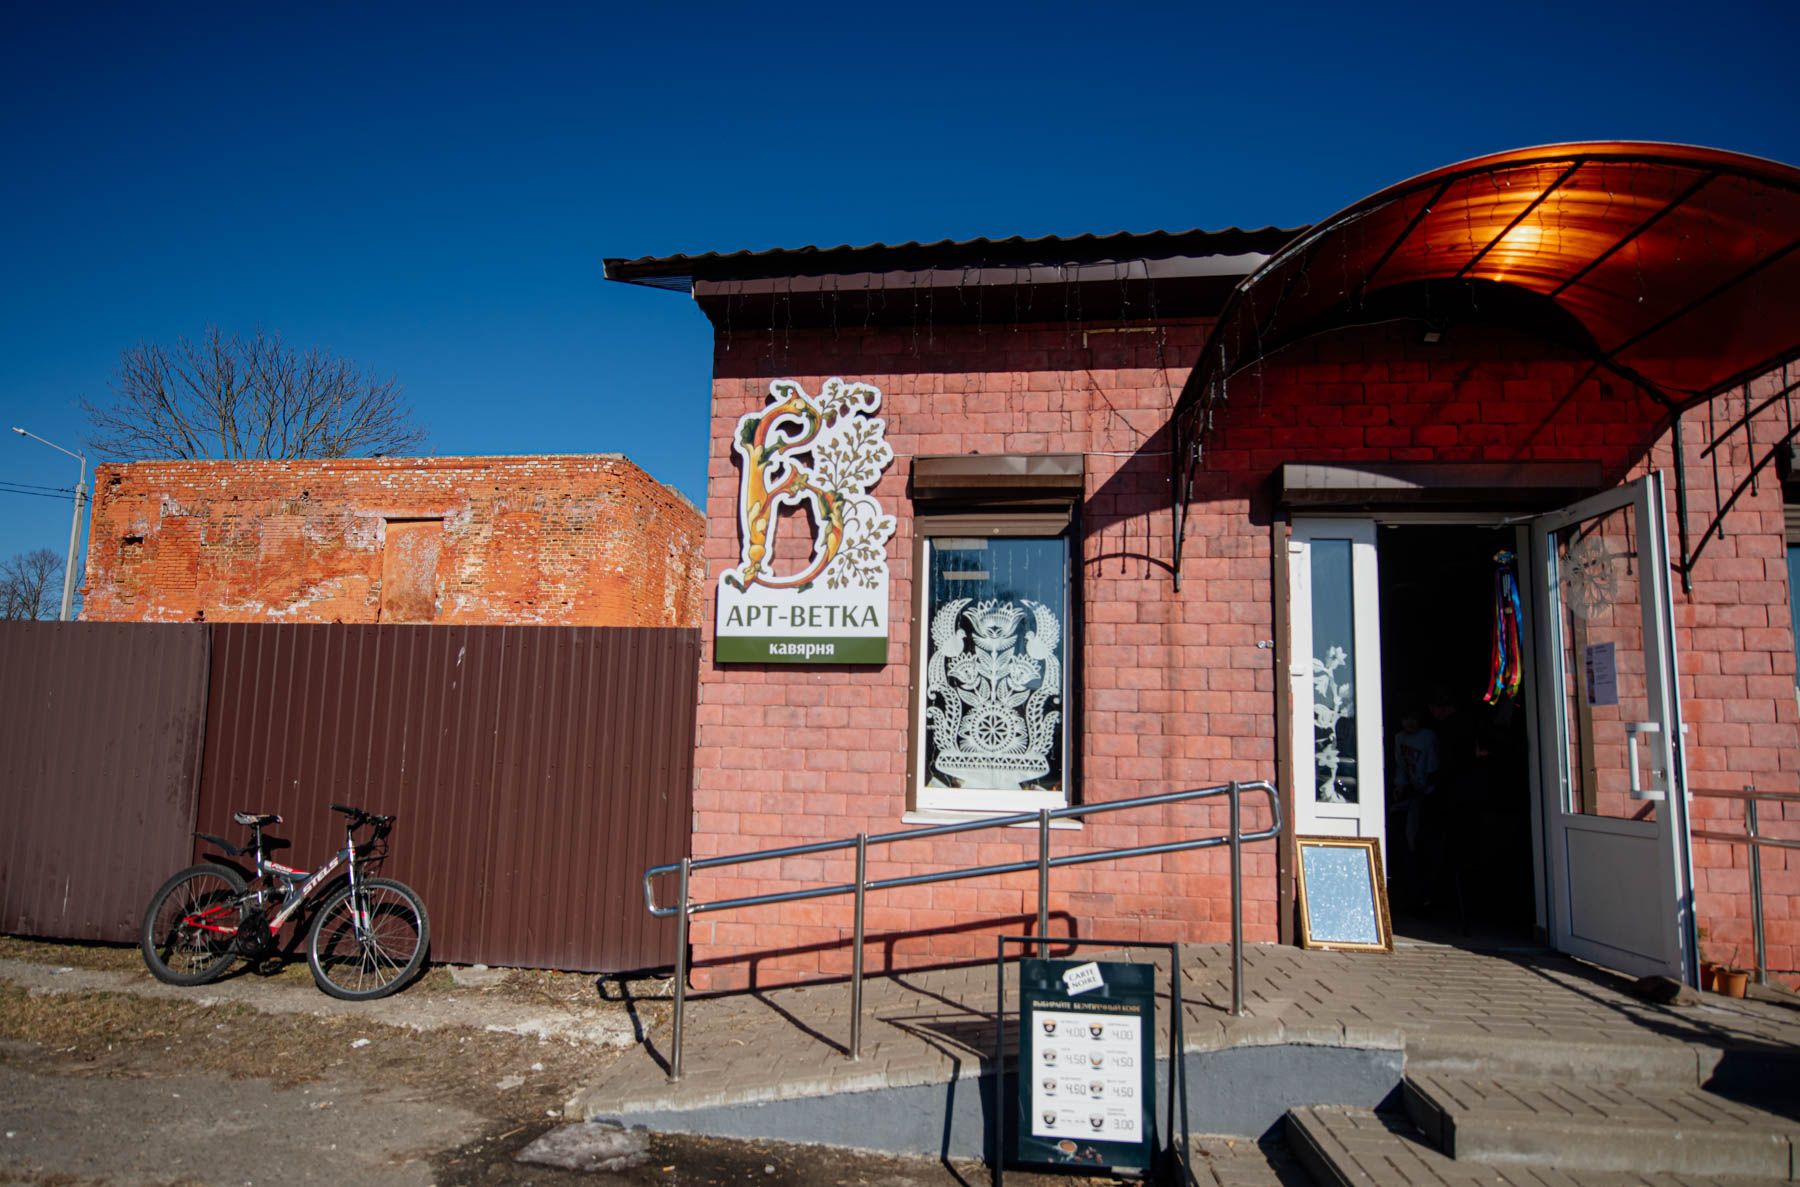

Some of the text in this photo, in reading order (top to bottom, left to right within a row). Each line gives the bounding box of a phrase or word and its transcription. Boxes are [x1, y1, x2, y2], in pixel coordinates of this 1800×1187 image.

[726, 605, 879, 628] АРТ-ВЕТКА
[769, 643, 835, 659] кавярня
[302, 857, 339, 896] STELS
